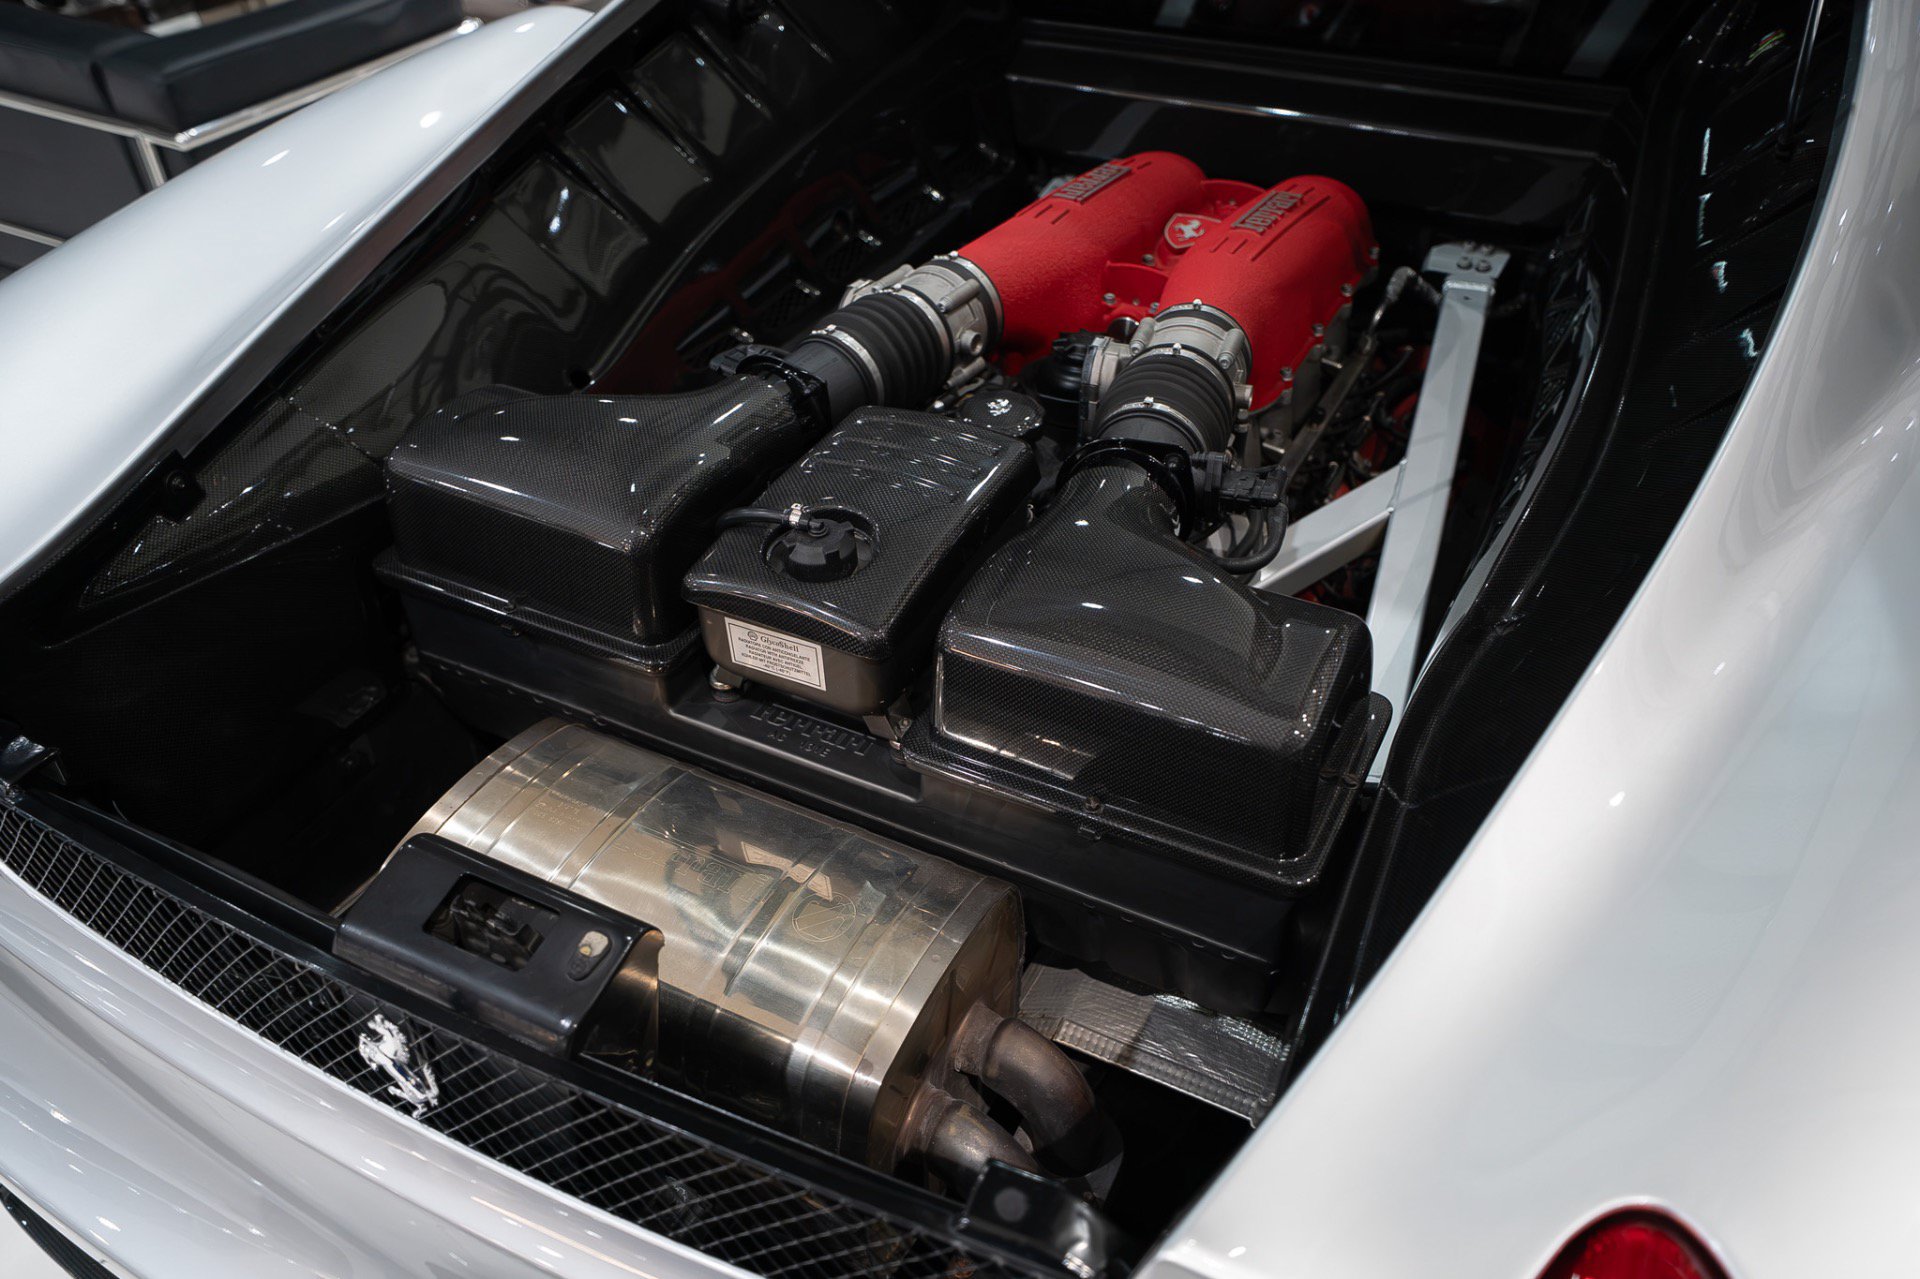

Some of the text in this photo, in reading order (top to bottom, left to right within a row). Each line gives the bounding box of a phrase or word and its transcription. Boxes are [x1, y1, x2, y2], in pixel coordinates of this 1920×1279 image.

[1231, 189, 1303, 232] Ferrari
[760, 636, 799, 652] GlycoShell
[750, 701, 876, 755] Ferrari
